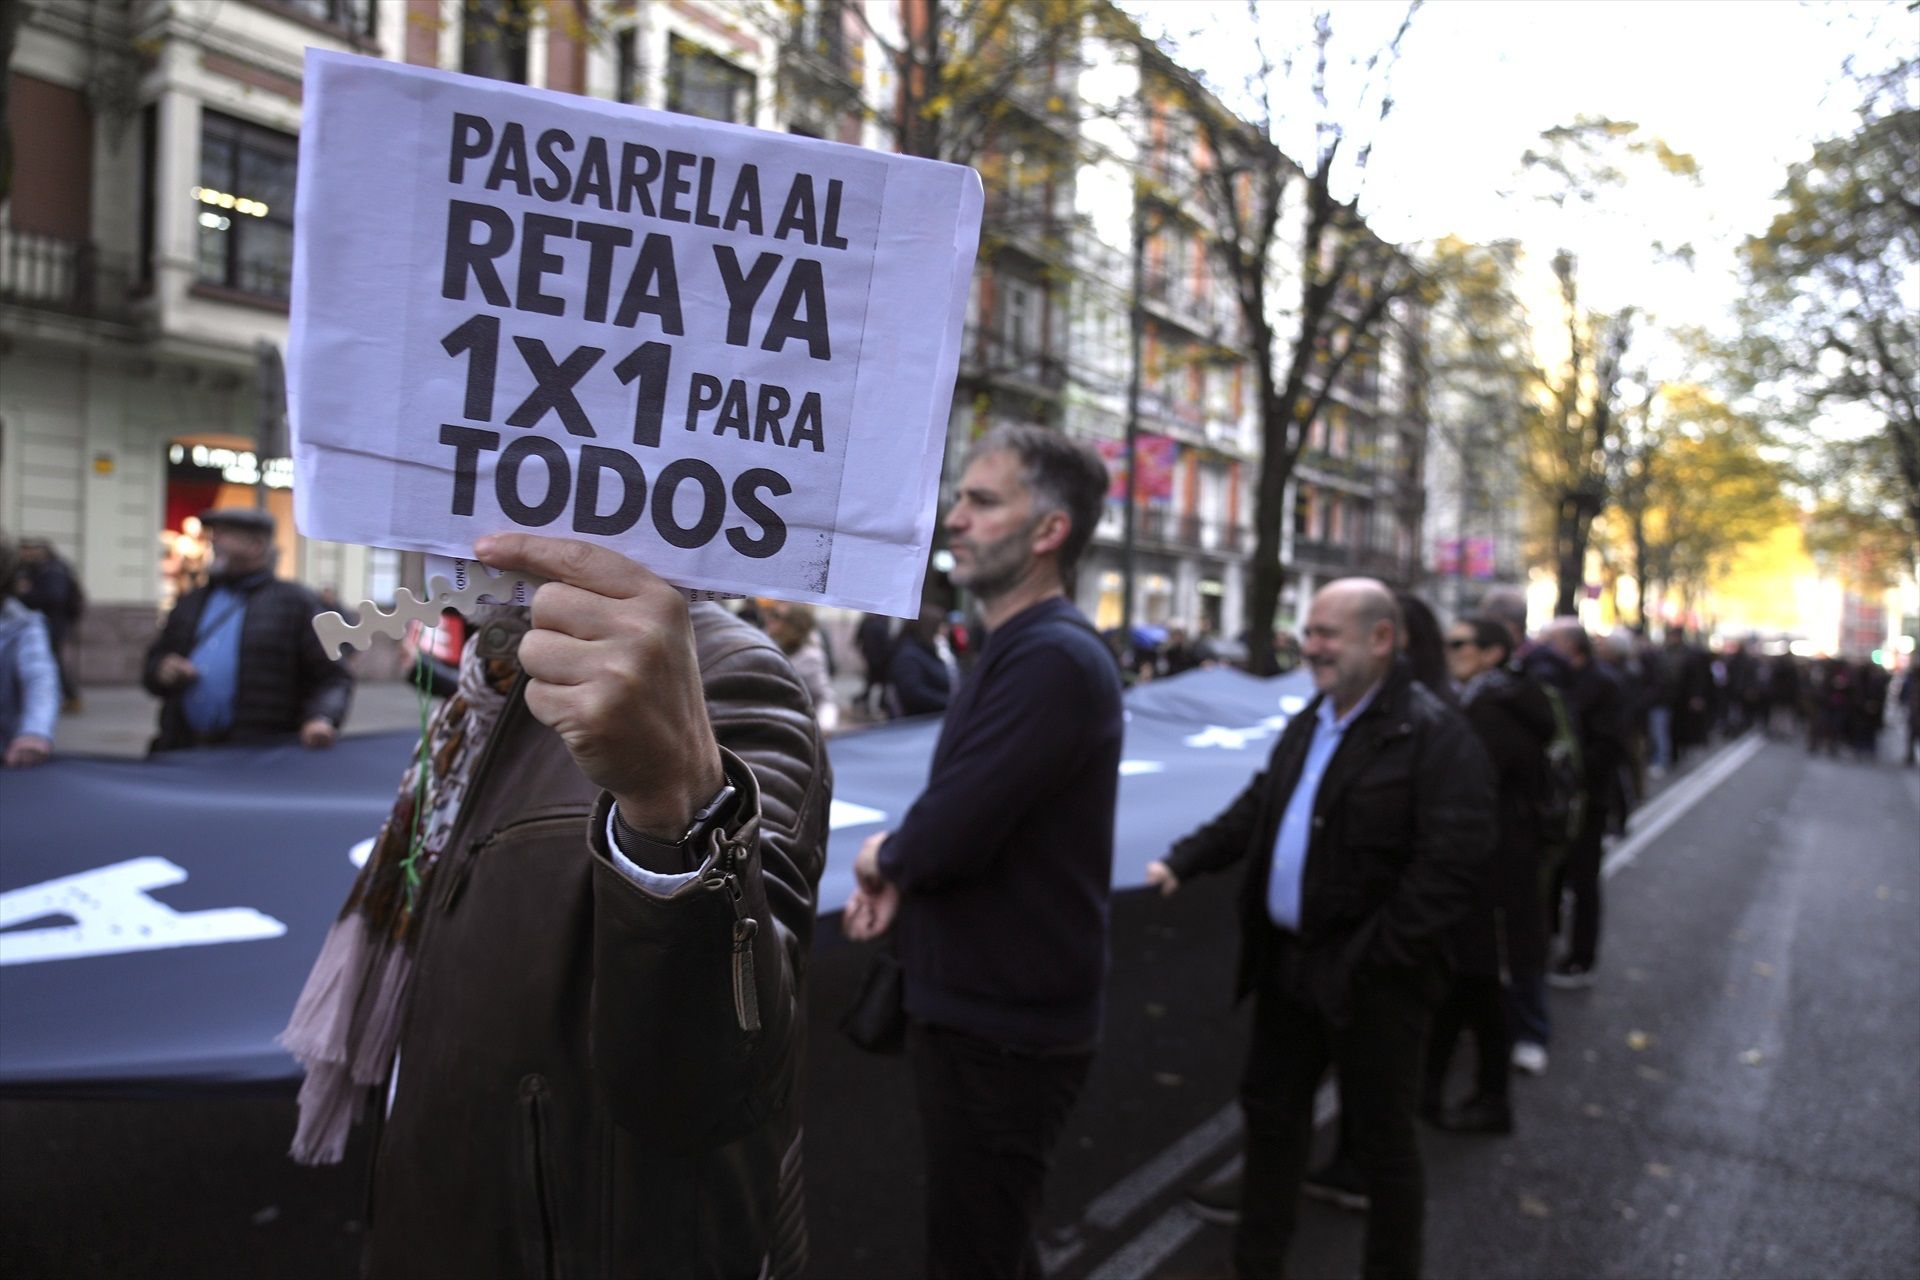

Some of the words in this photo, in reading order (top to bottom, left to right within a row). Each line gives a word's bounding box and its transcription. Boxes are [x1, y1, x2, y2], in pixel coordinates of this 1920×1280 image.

[448, 111, 764, 236] PASARELA
[773, 172, 849, 251] AL
[441, 198, 685, 337] RETA
[712, 243, 832, 361] YA
[685, 372, 825, 453] PARA
[438, 423, 793, 559] TODOS
